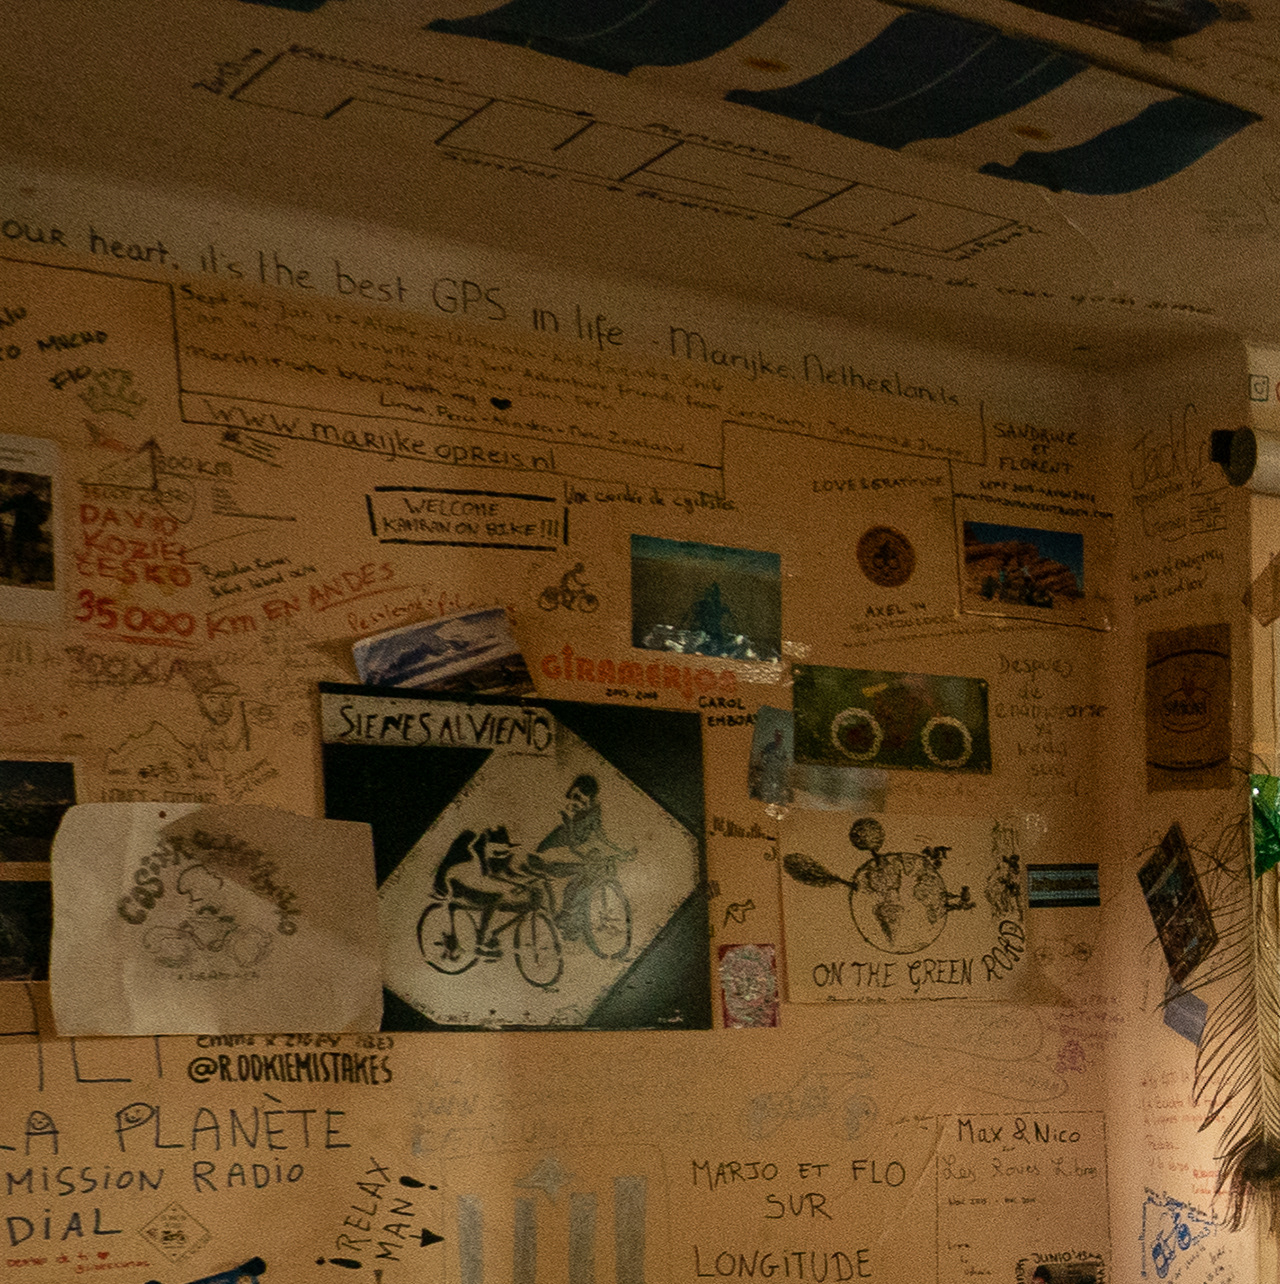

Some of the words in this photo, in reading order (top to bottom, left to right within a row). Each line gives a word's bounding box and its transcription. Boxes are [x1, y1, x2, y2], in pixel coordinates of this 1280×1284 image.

[258, 250, 312, 291] the
[335, 260, 410, 304] best
[432, 277, 508, 323] GPS
[533, 307, 559, 333] in
[576, 304, 624, 351] life
[803, 354, 960, 406] Netherlands
[401, 497, 501, 518] WELCOME
[115, 1091, 351, 1153] PLANÈTE
[956, 1118, 1003, 1144] Max
[1033, 1121, 1082, 1144] Nico
[798, 1162, 829, 1181] ET
[852, 1159, 907, 1188] FLO
[765, 1192, 834, 1222] SUR
